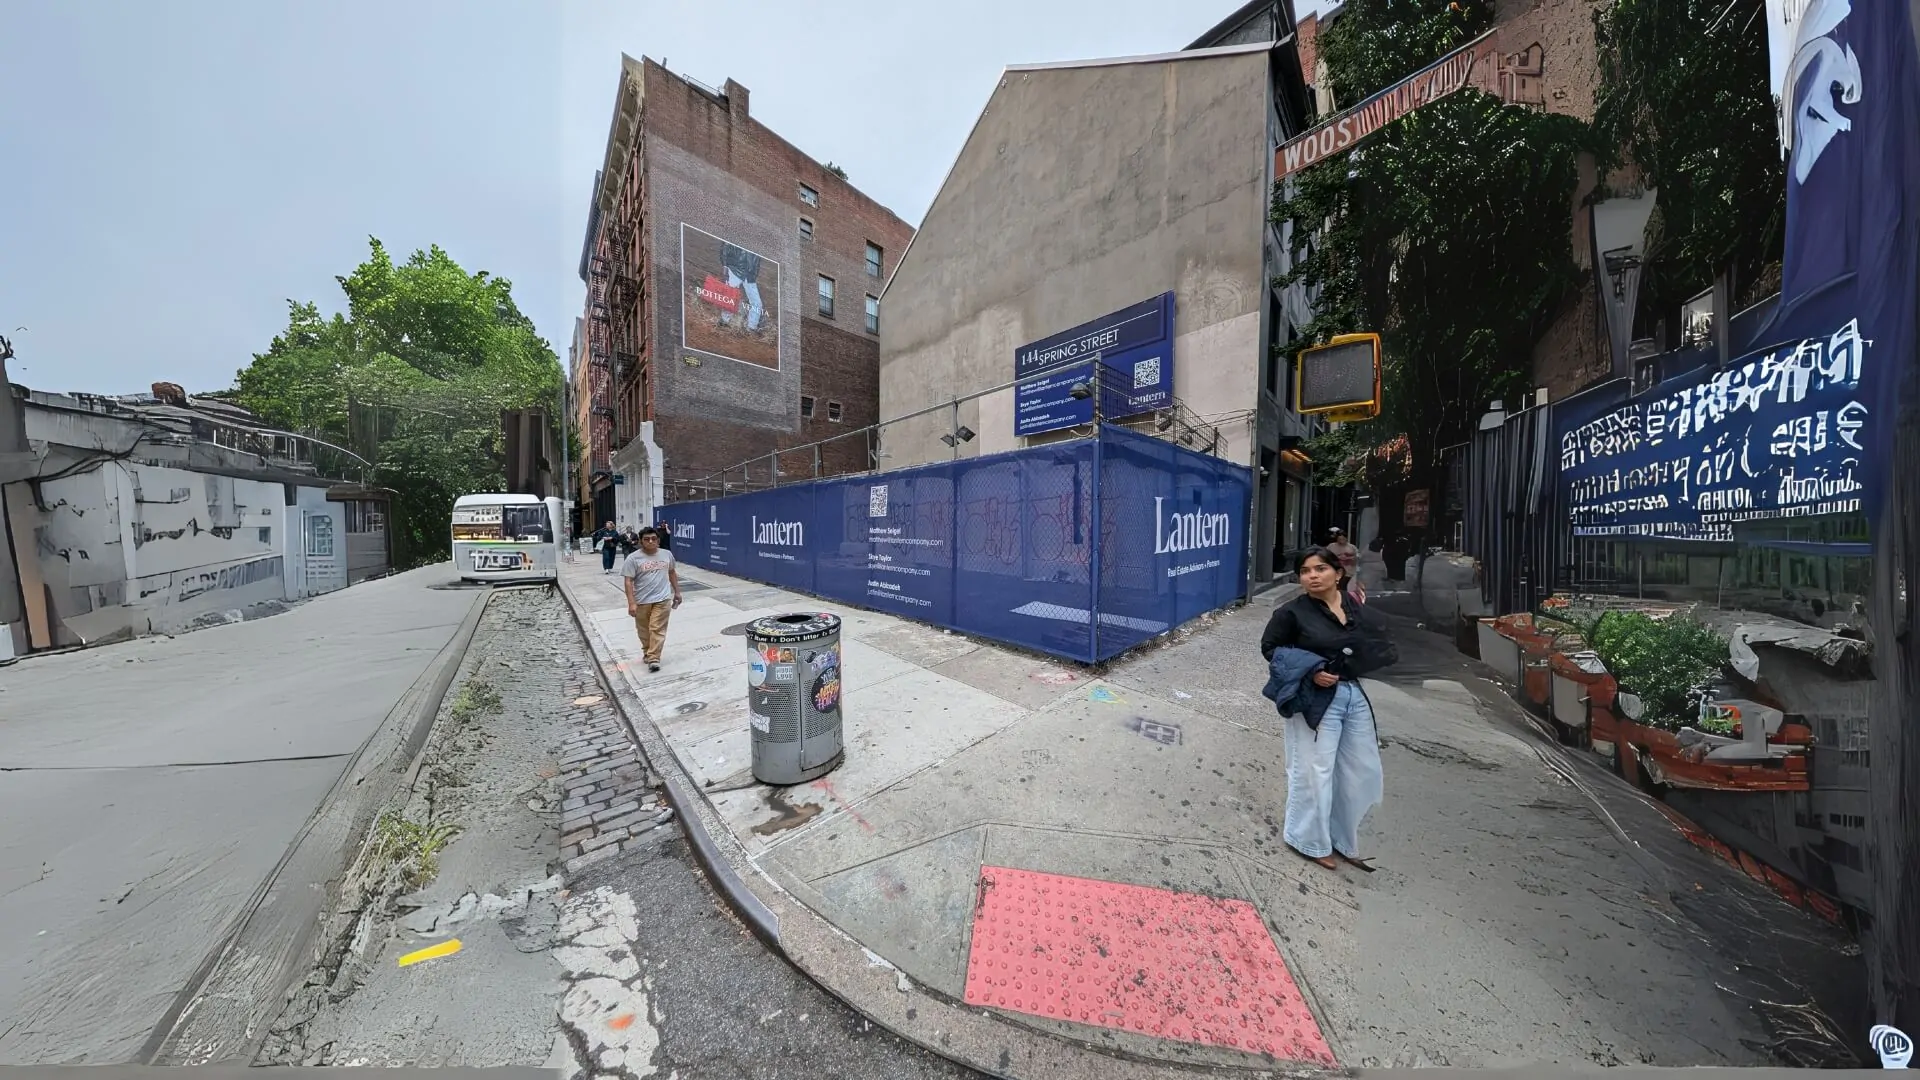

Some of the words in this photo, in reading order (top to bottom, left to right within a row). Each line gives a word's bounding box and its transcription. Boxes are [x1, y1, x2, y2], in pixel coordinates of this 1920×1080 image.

[696, 286, 735, 306] BOTTEGA
[1022, 349, 1038, 365] 144
[1038, 343, 1078, 365] SPRING
[1080, 328, 1119, 352] STREET
[752, 515, 803, 546] Lantern
[1153, 496, 1230, 554] Lantern
[780, 635, 801, 643] Don't
